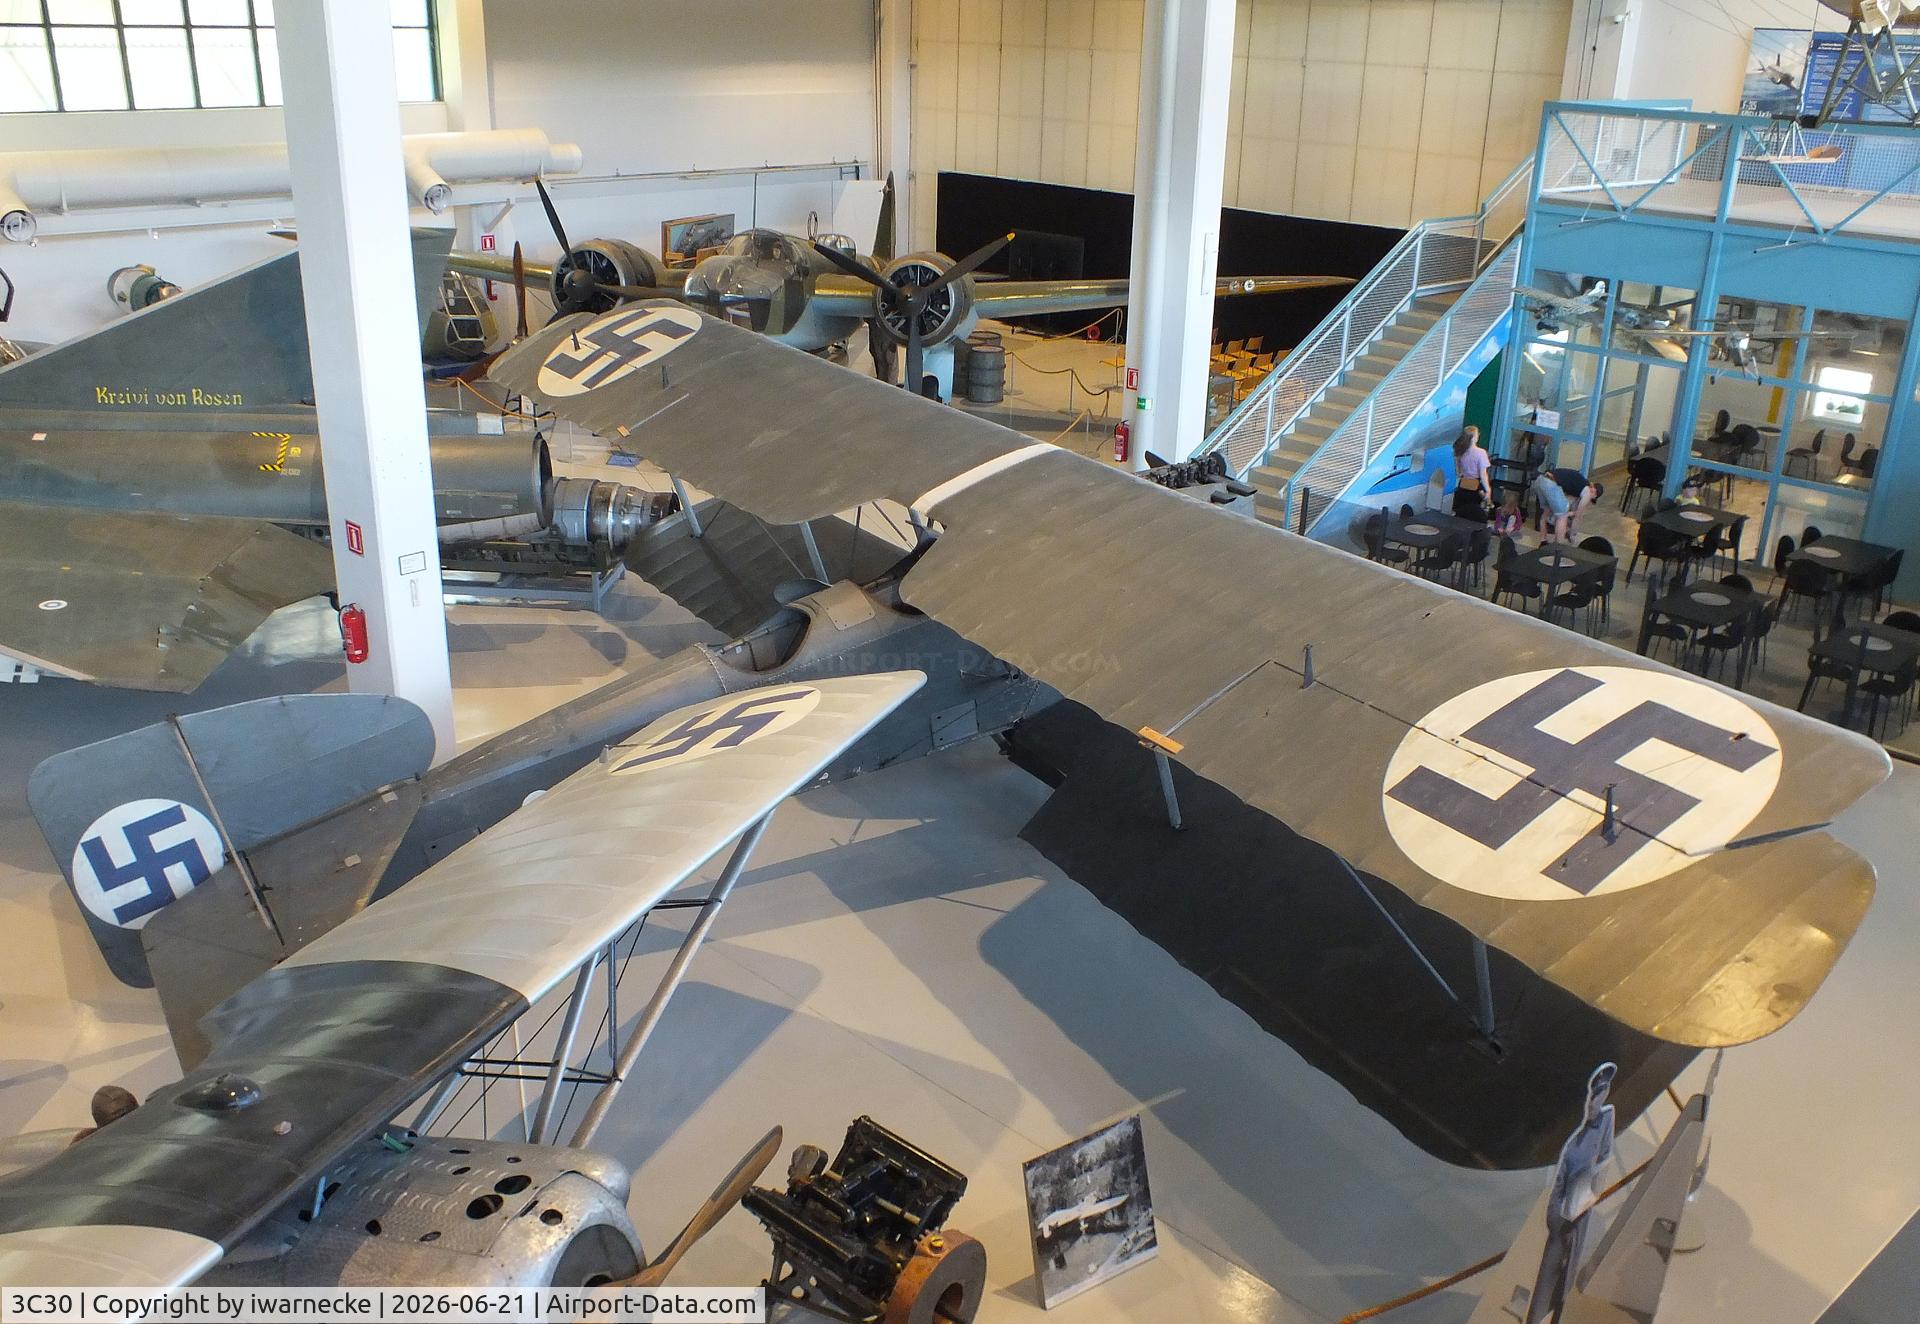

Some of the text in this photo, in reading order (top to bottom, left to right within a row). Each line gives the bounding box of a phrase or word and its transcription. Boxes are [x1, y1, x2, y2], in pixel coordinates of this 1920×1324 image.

[95, 386, 243, 406] Kreivi von Rosen
